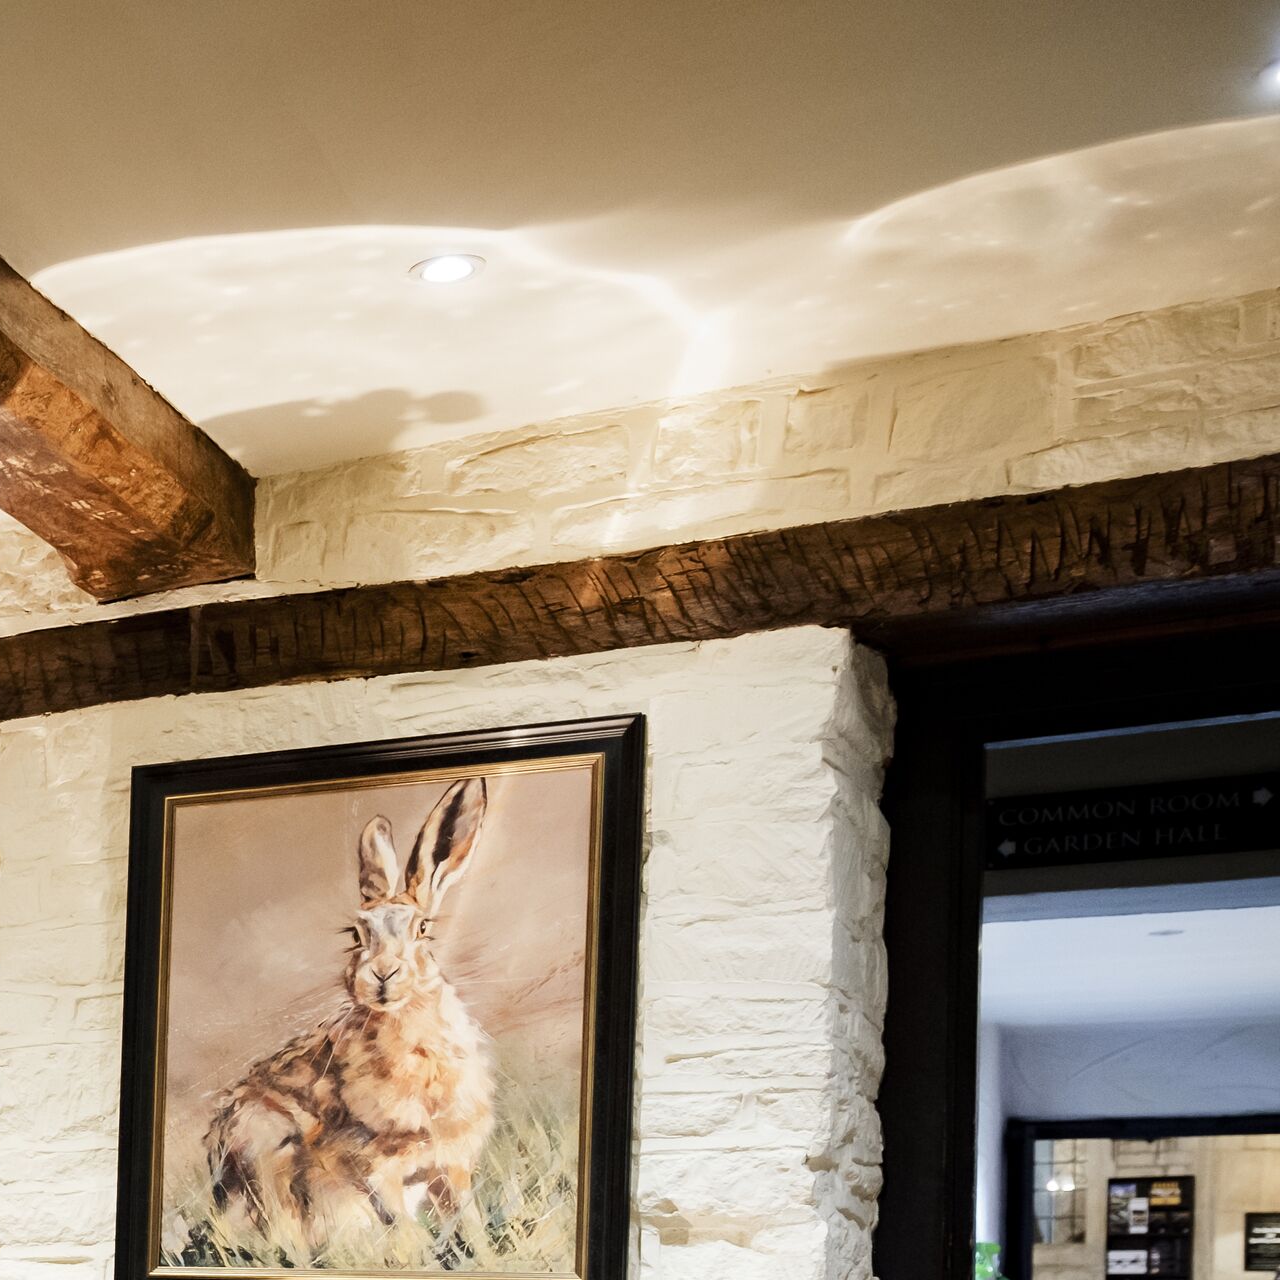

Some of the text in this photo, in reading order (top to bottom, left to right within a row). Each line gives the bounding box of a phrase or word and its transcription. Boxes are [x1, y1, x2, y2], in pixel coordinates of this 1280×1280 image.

[998, 791, 1241, 827] COMMON ROOM
[1023, 824, 1228, 856] GARDEN HALL
